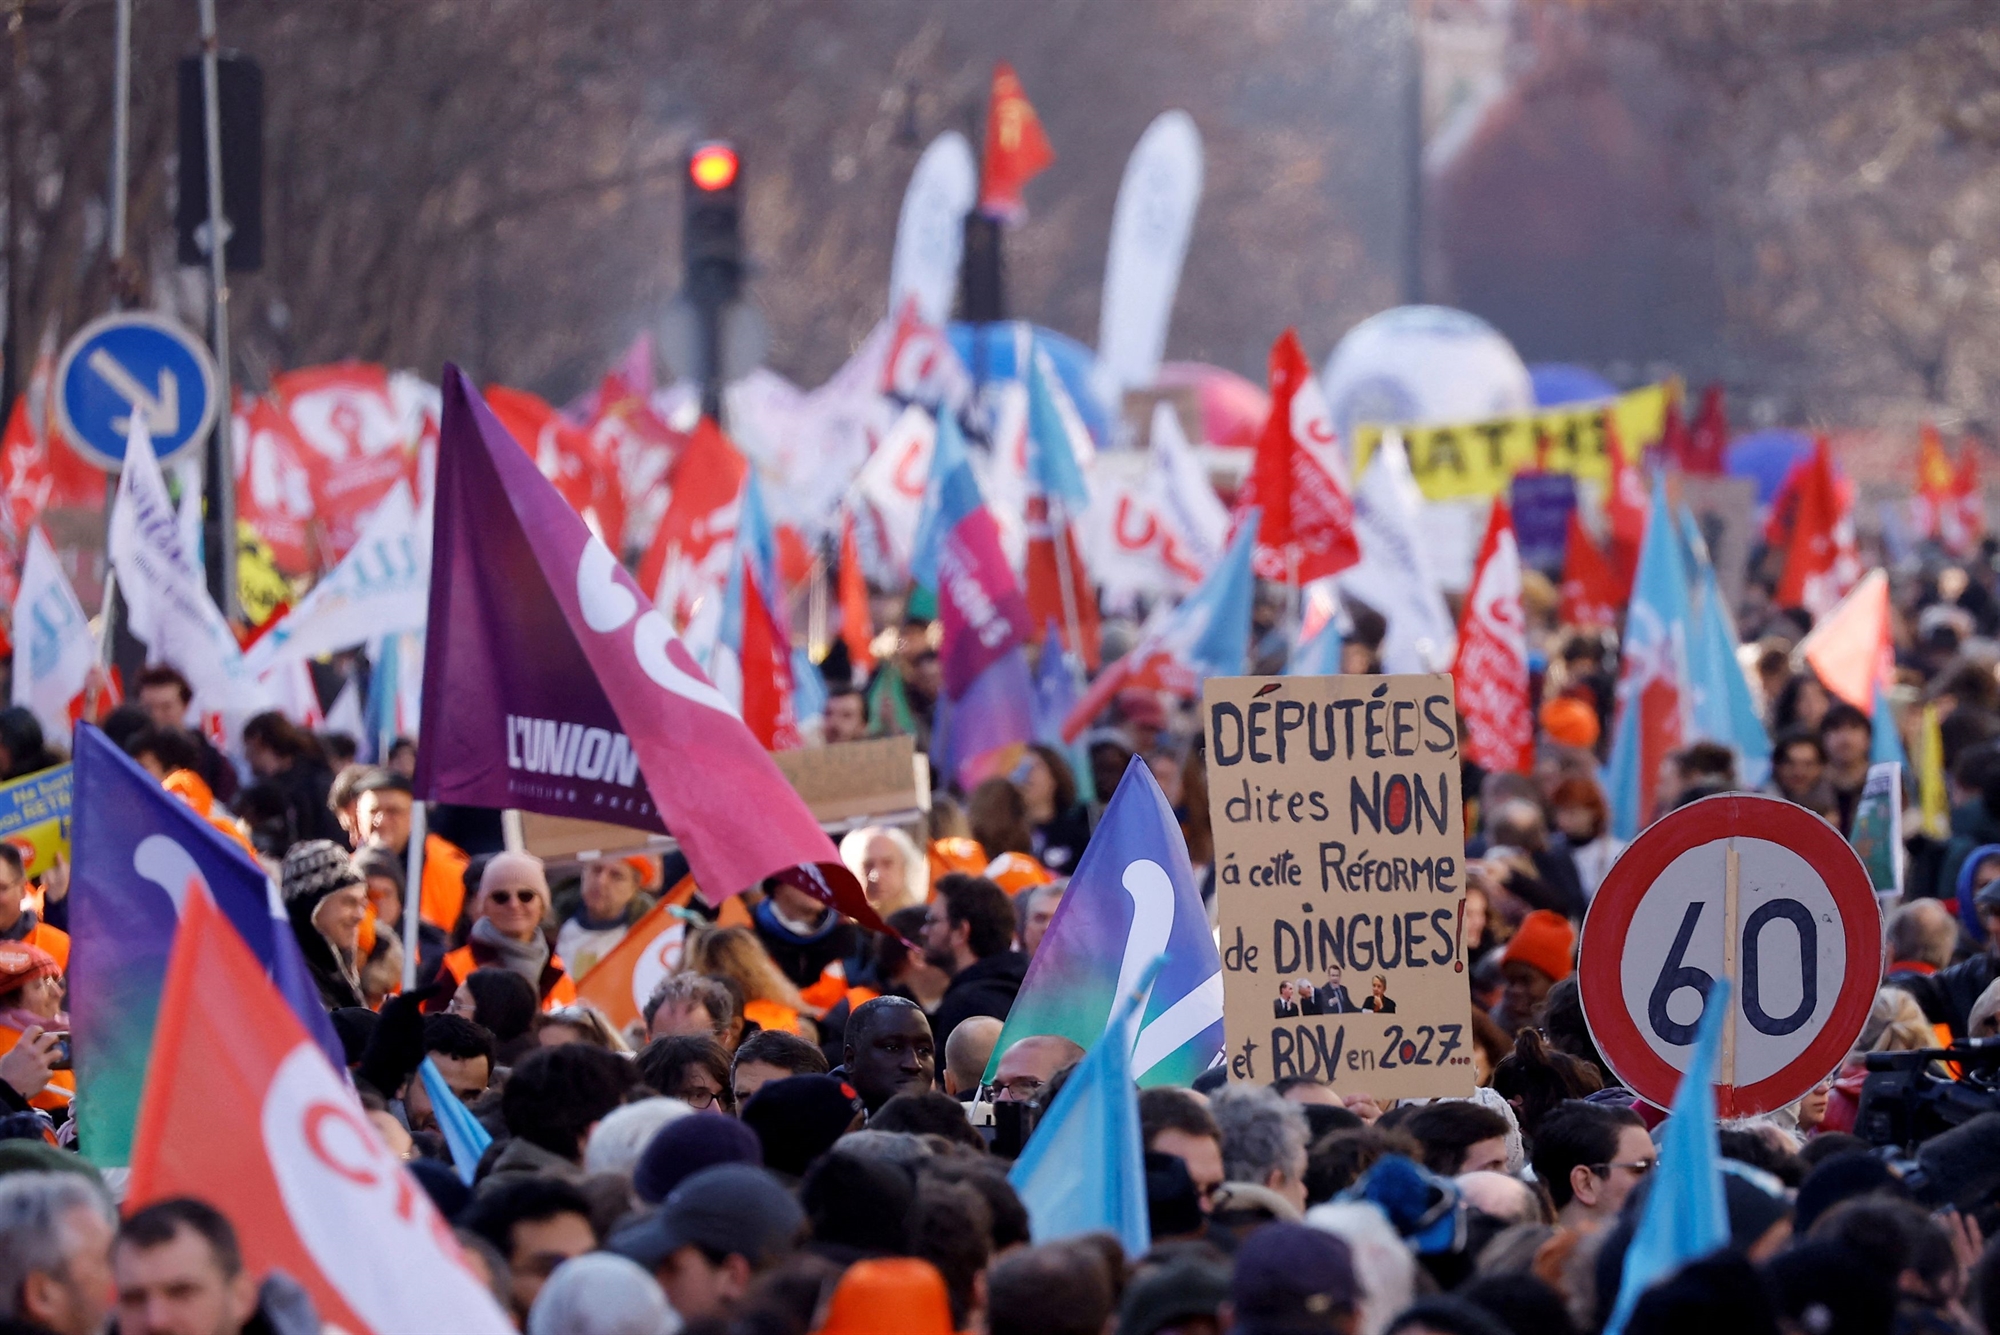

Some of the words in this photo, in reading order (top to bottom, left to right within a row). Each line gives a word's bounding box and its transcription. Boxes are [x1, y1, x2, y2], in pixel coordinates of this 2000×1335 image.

[507, 713, 639, 788] L'UNION
[1224, 778, 1330, 824] dites
[1350, 770, 1449, 836] NON
[1248, 848, 1302, 887] cette
[1224, 925, 1259, 974] de
[1648, 898, 1818, 1046] 60
[1231, 1035, 1260, 1080] et
[1271, 1024, 1345, 1082] RDV
[1346, 1048, 1376, 1071] en
